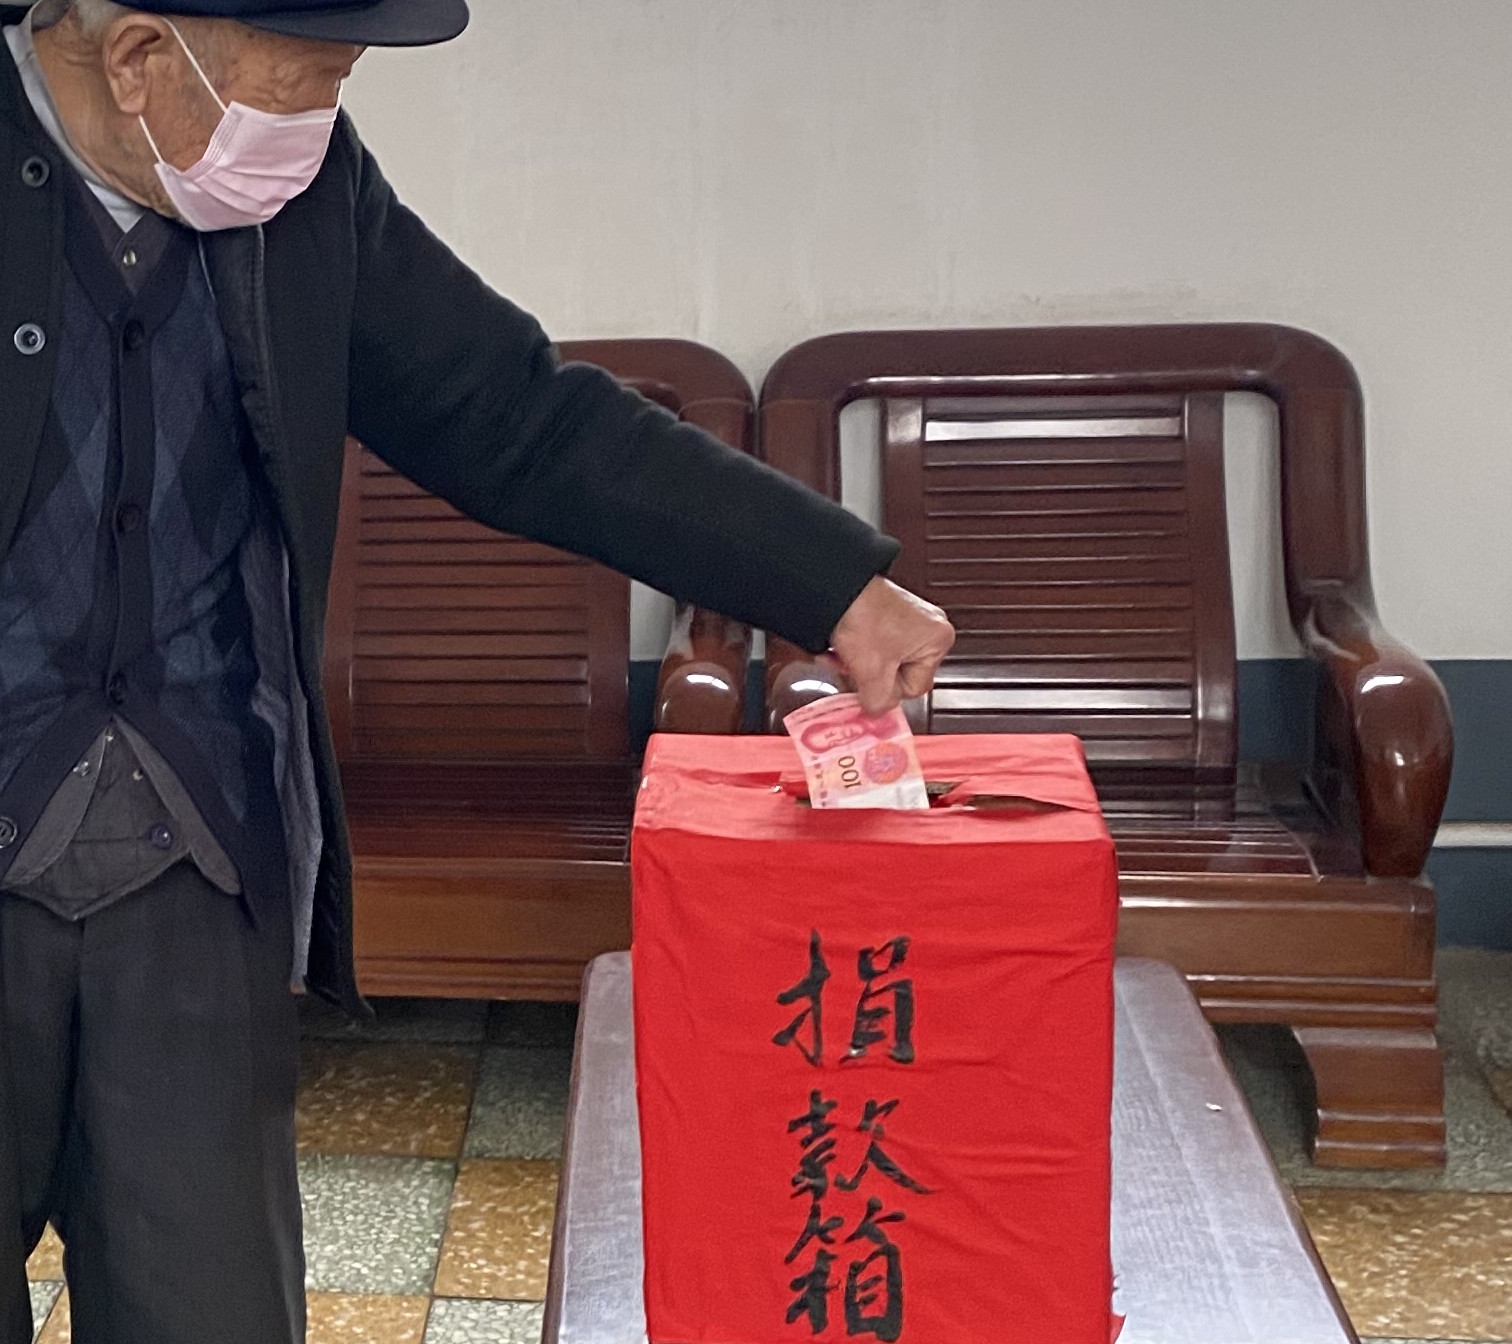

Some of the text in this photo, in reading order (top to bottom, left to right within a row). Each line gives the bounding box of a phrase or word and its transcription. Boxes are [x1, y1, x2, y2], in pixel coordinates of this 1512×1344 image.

[838, 756, 861, 789] 100
[771, 928, 938, 1343] 捐款箱
